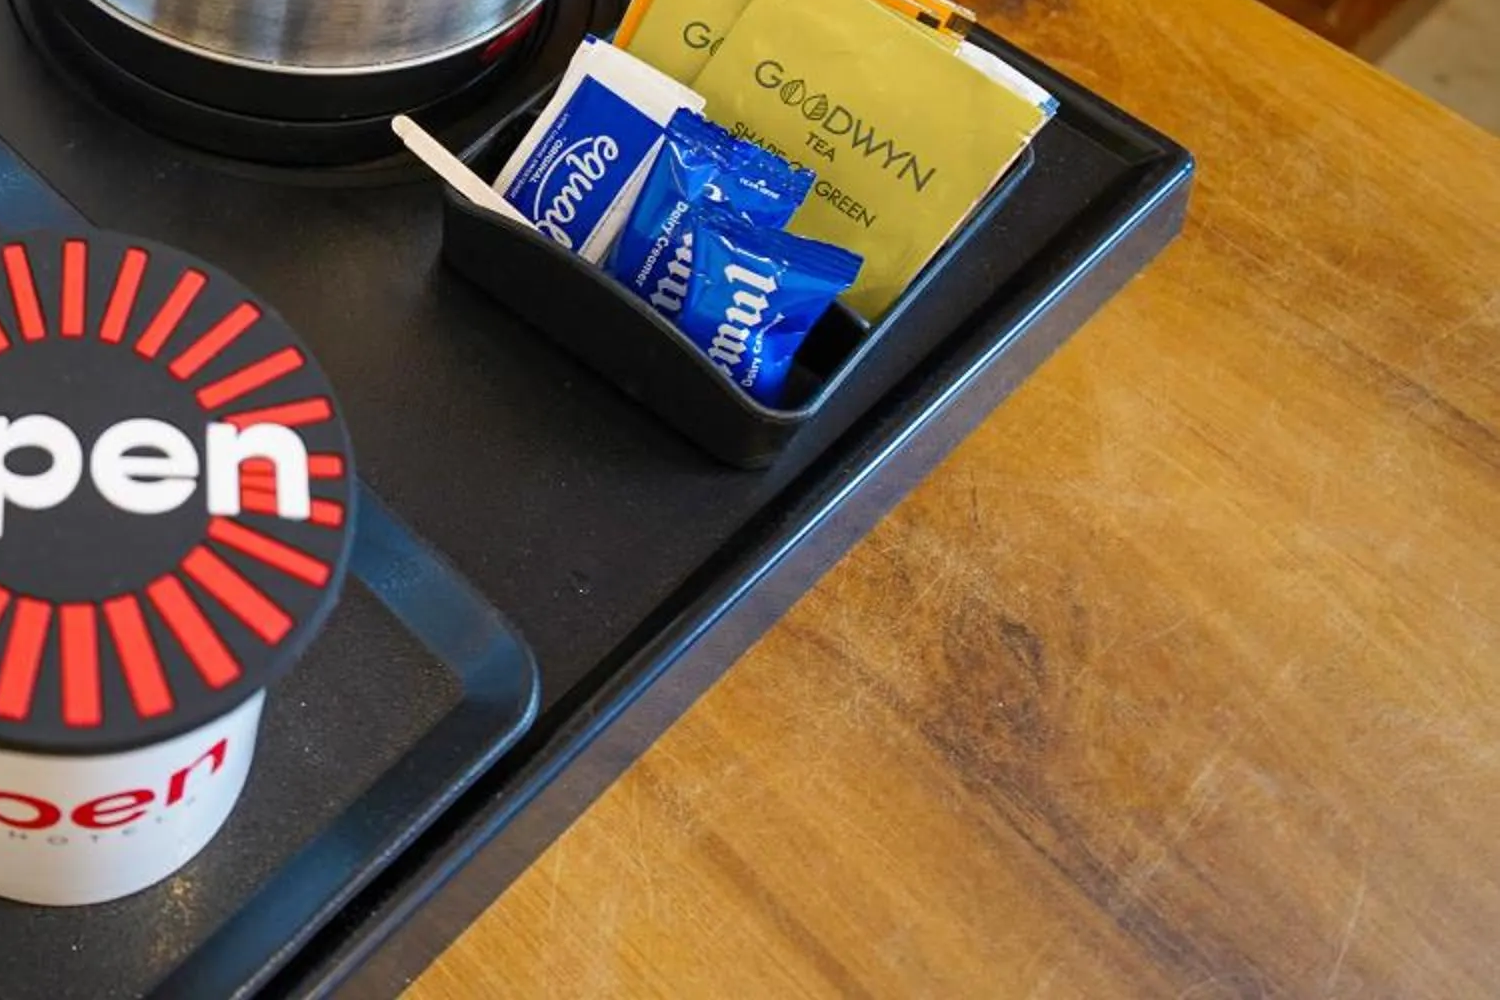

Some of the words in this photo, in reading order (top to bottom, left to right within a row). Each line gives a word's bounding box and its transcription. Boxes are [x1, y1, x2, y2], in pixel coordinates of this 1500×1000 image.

[805, 132, 837, 162] TEA
[661, 200, 689, 236] Dairy
[815, 181, 876, 229] GREEN
[635, 236, 670, 288] Creamer
[741, 356, 764, 387] Dairy
